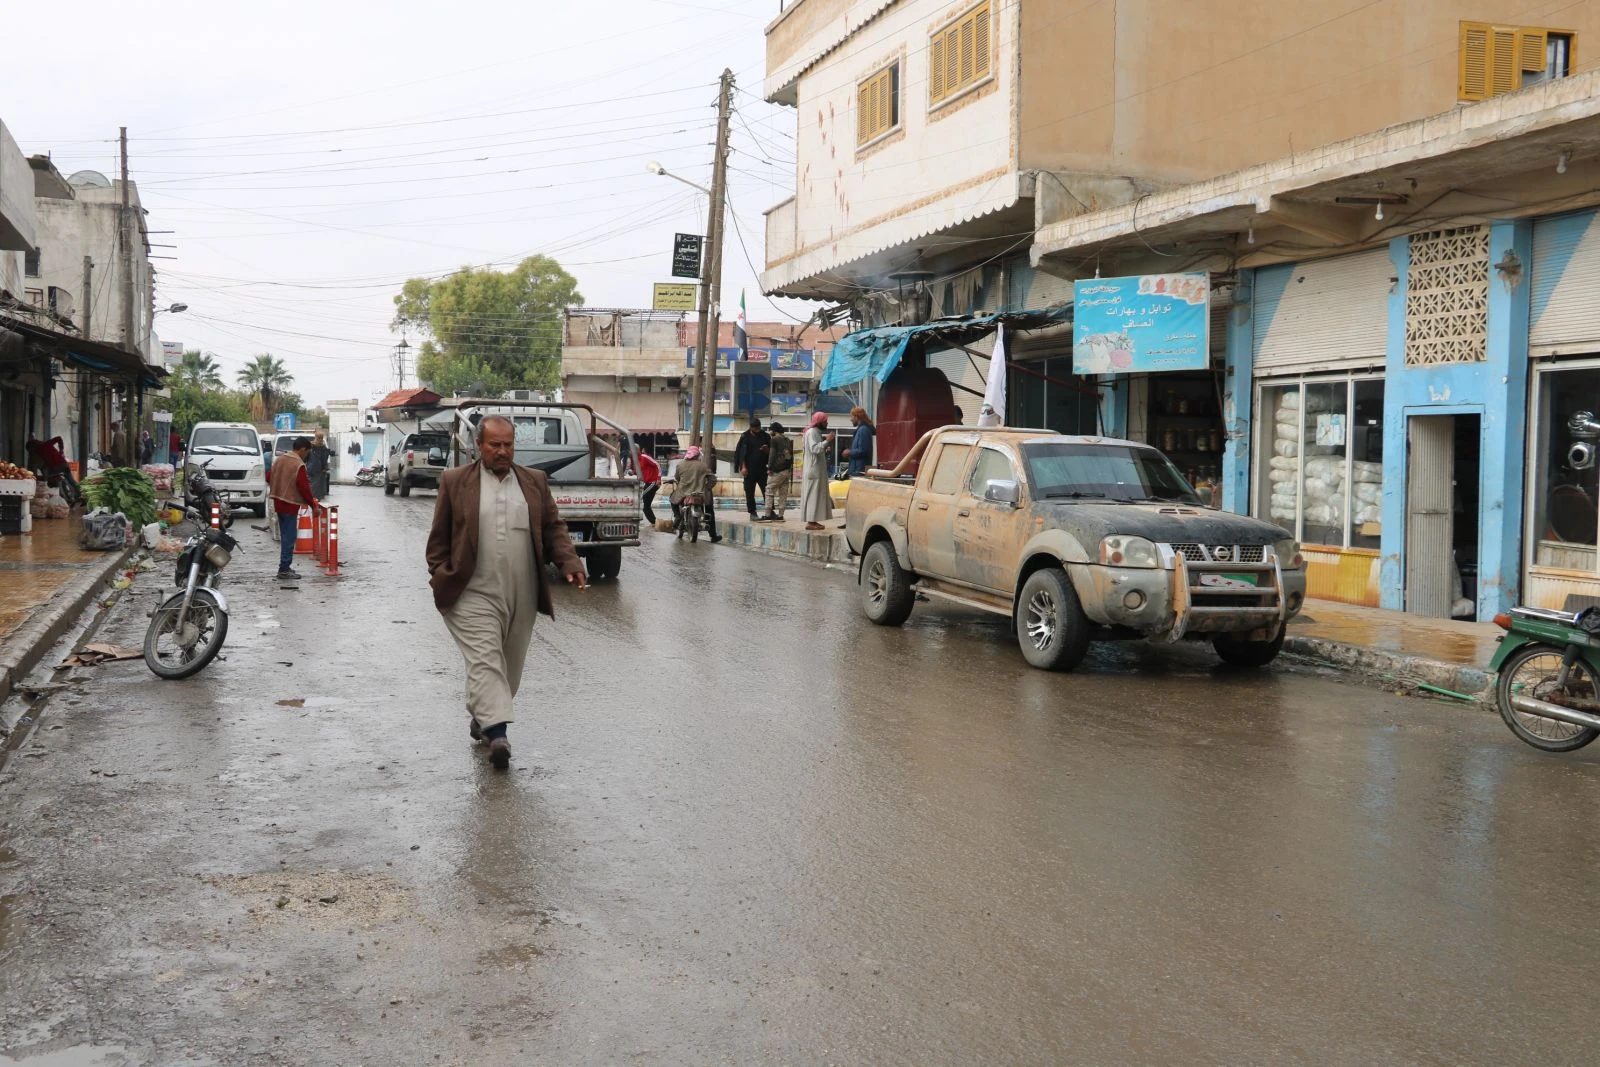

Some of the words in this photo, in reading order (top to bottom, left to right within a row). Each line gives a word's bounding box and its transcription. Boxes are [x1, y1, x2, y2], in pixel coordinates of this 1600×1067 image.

[1107, 306, 1136, 317] بهارات
[555, 496, 572, 505] فقط
[573, 496, 597, 507] عيناك
[598, 496, 617, 507] تدمع
[619, 496, 634, 506] وقد
